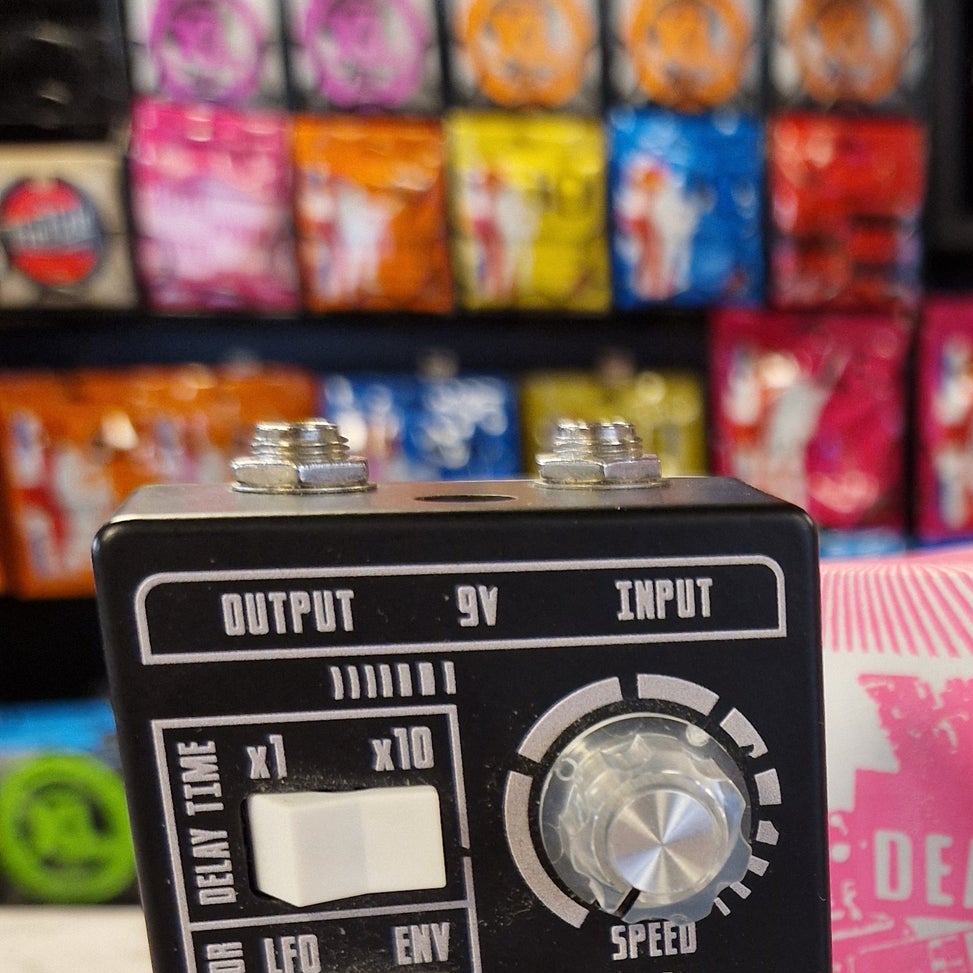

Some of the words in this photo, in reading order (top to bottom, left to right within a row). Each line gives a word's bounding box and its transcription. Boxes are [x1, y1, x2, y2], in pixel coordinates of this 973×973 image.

[221, 589, 355, 636] OUTPUT
[457, 584, 500, 628] 9V
[615, 578, 714, 622] INPUT
[246, 734, 288, 780] x1
[371, 726, 435, 772] x10
[177, 740, 225, 817] TIME
[189, 828, 237, 906] DELAY
[393, 922, 450, 965] ENV
[610, 924, 698, 960] SPEED
